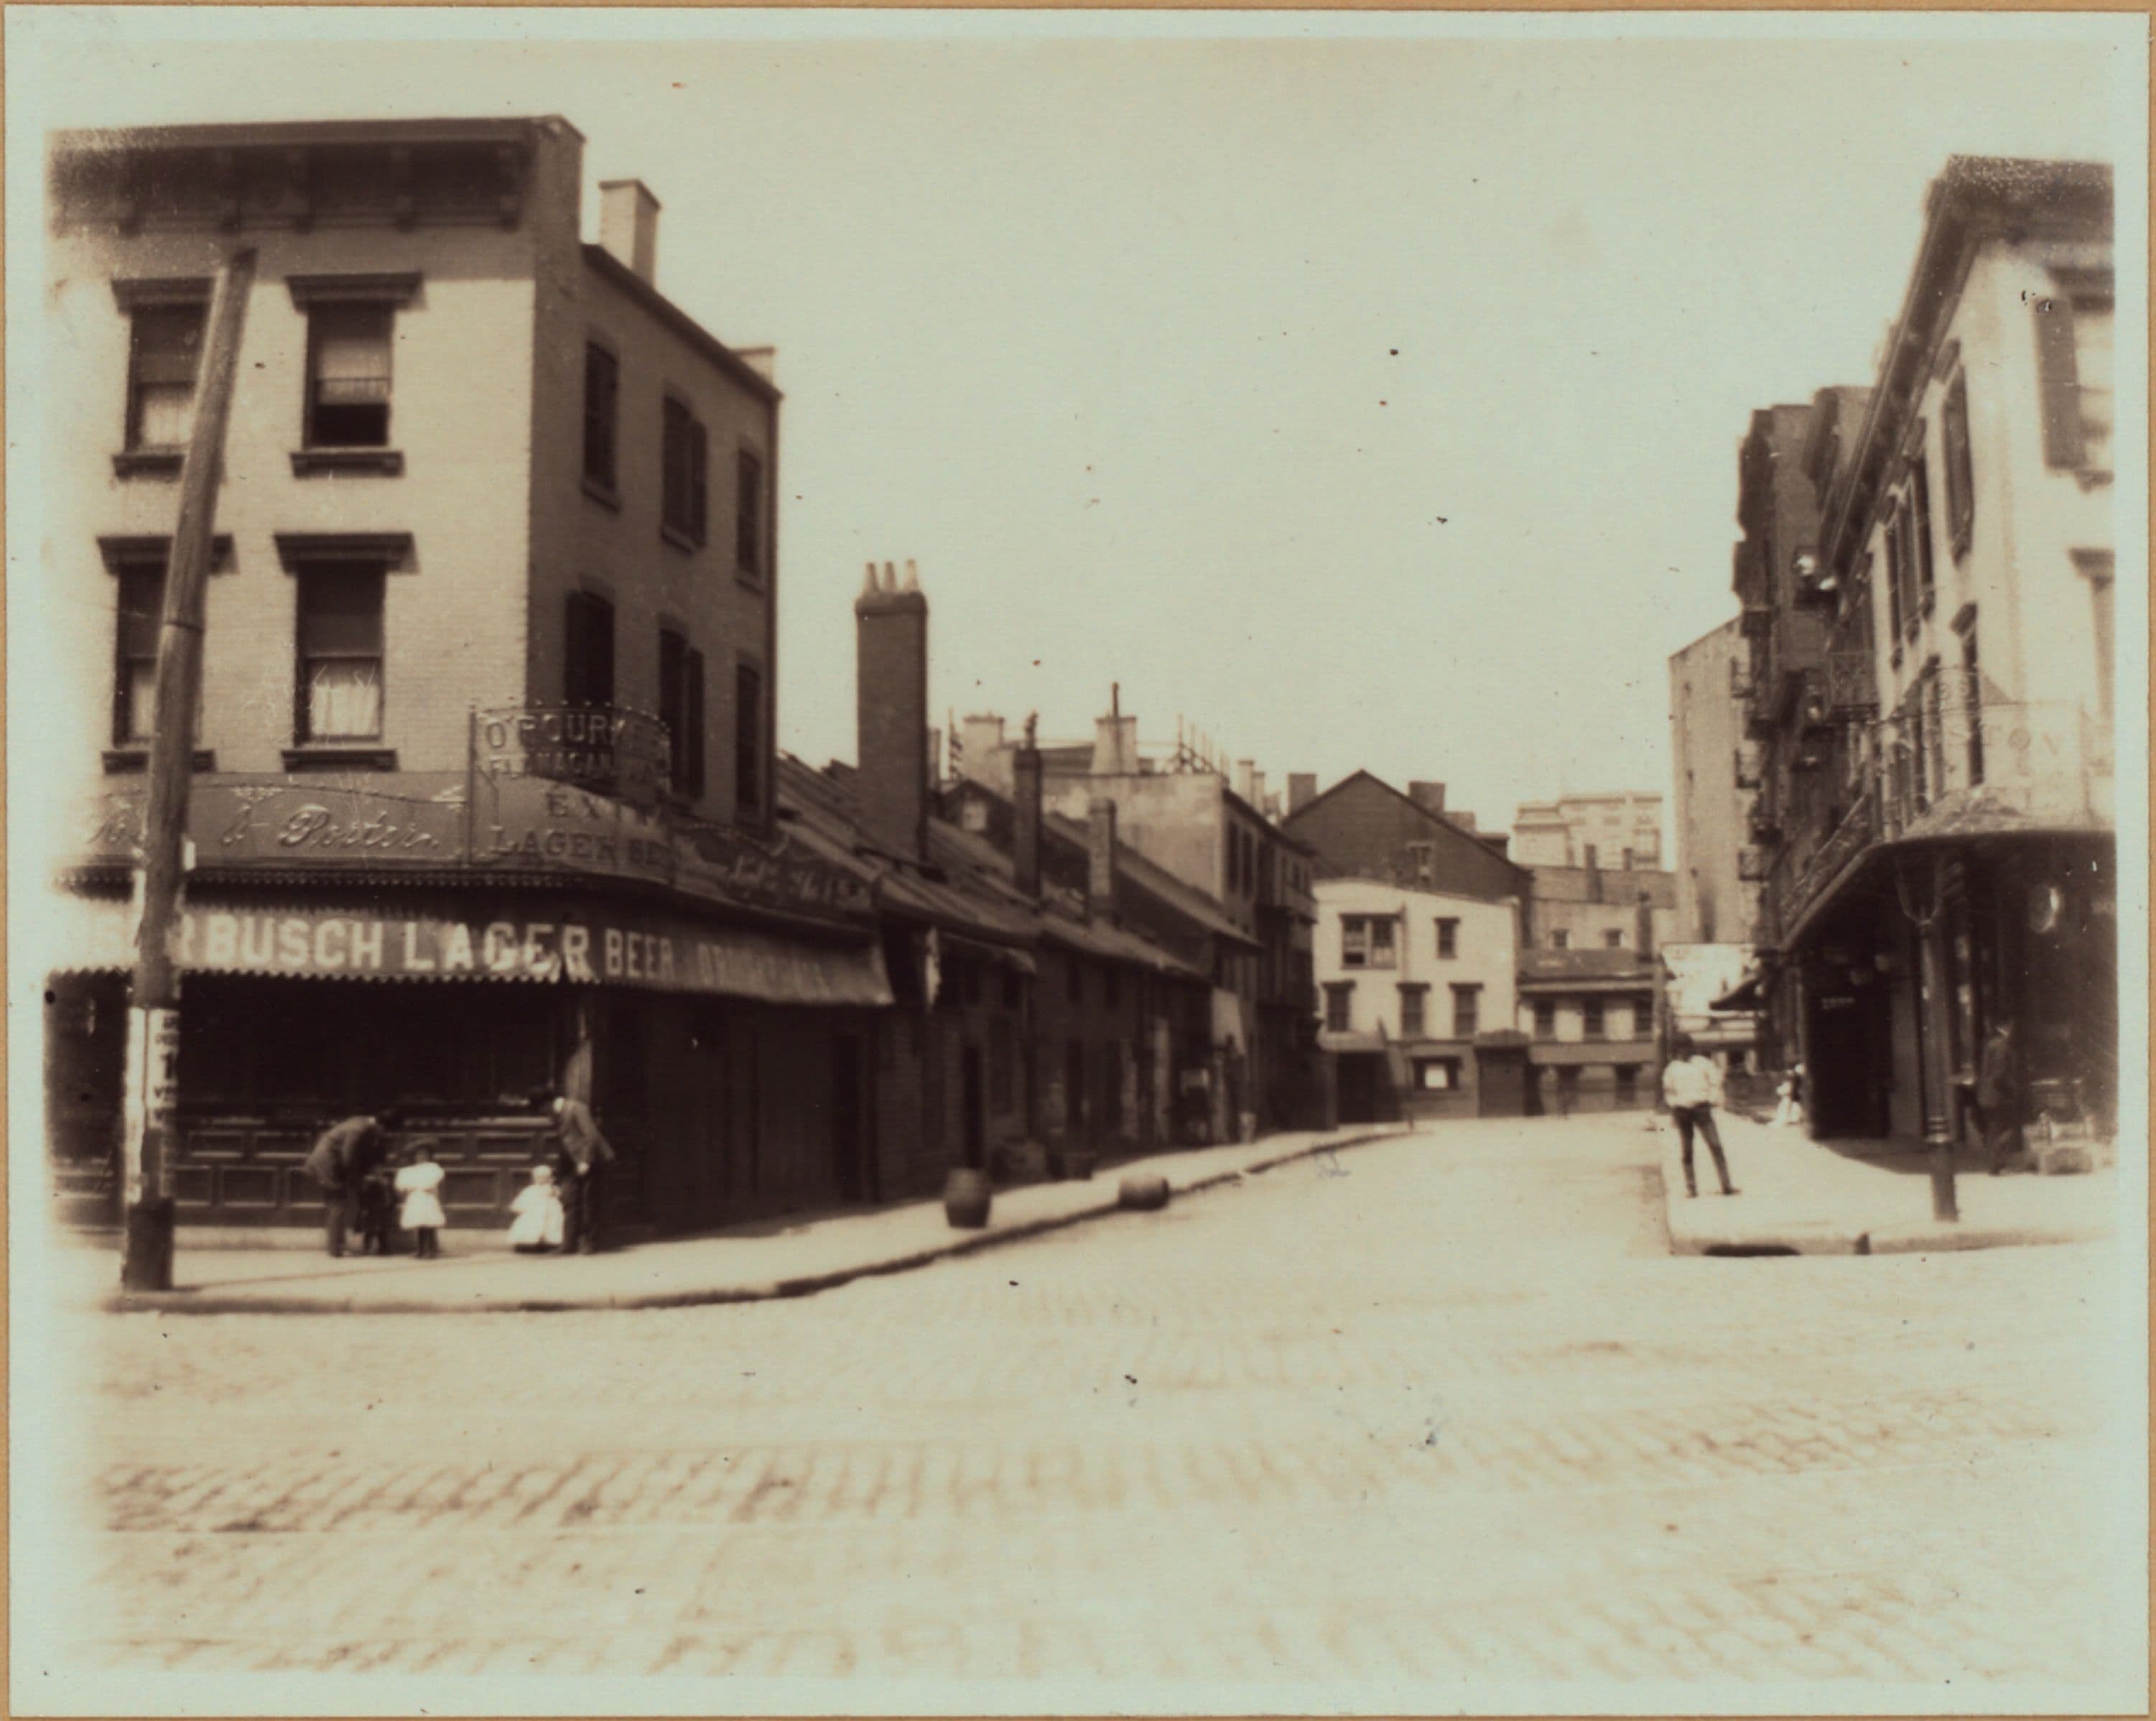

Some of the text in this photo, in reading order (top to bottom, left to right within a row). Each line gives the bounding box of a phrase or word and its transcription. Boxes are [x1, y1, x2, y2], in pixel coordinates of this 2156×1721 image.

[488, 826, 616, 868] LAGER
[205, 913, 384, 969] BUSCH
[405, 919, 596, 980] LAGER
[604, 927, 676, 982] BEER
